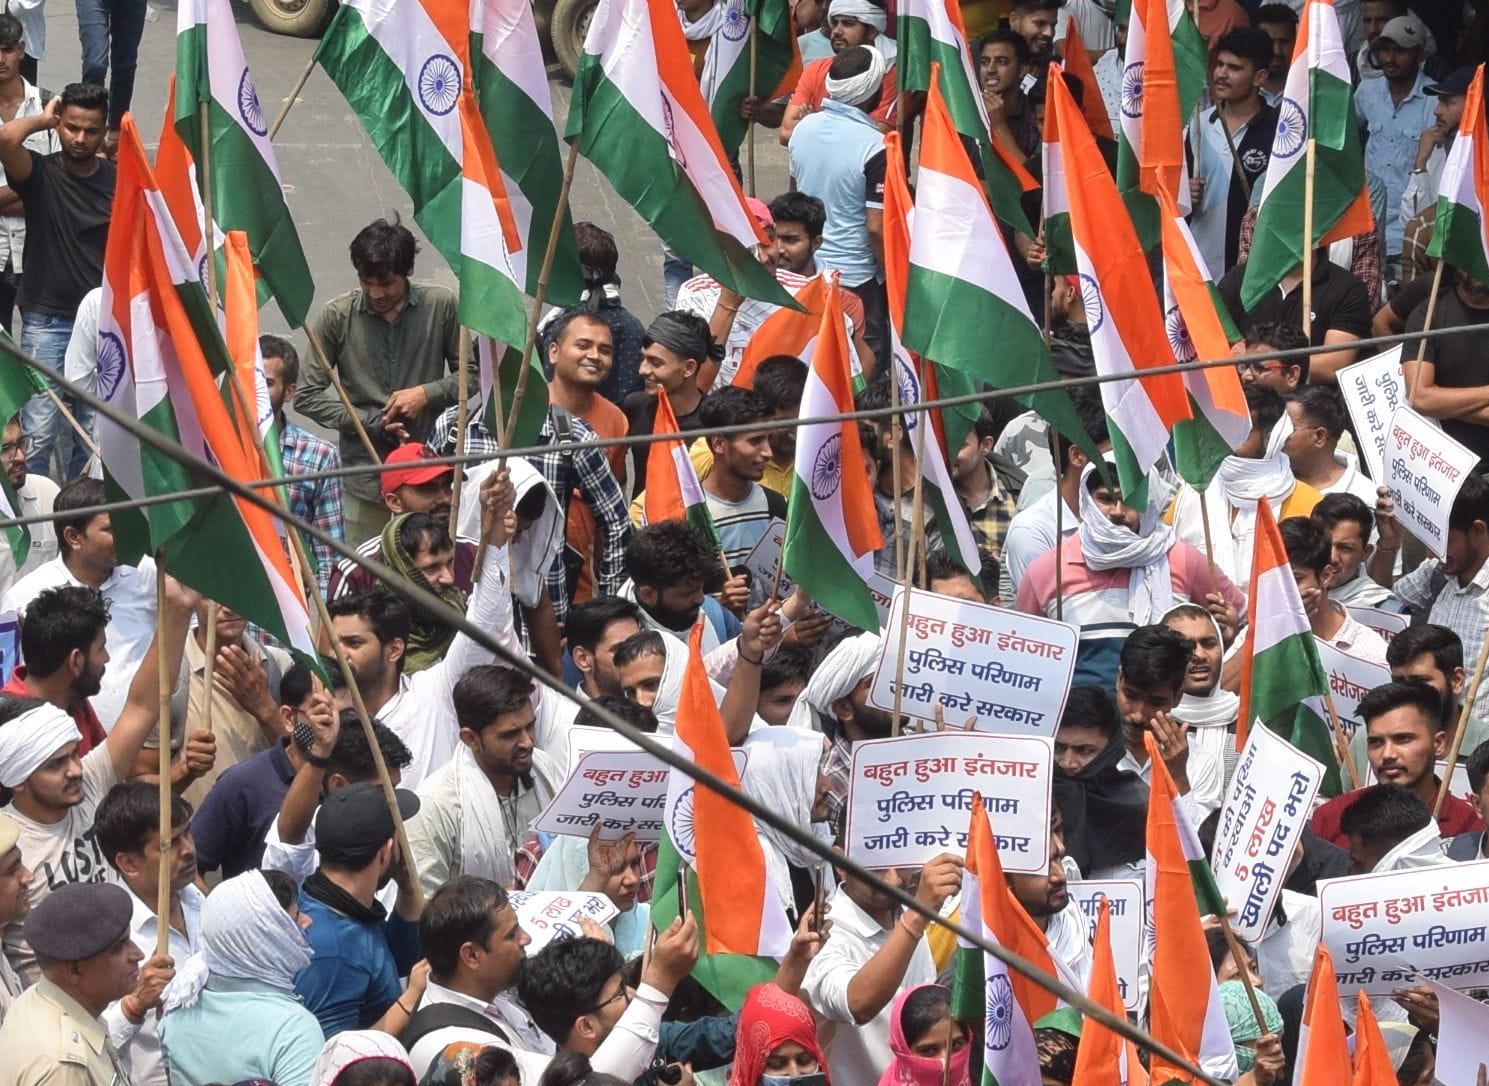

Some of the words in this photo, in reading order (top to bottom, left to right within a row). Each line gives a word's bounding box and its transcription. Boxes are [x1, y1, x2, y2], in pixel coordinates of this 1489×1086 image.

[1392, 424, 1412, 450] बहुत
[1410, 438, 1430, 461] हुआ
[1428, 451, 1461, 483] इंतजार
[1391, 458, 1414, 483] पुलिस
[1413, 476, 1442, 508] परिणाम
[1416, 511, 1442, 541] सरकार
[951, 623, 992, 648] हुआ
[997, 630, 1066, 661] इंतजार
[907, 648, 966, 675] पुलिस
[971, 661, 1042, 692] परिणाम
[938, 692, 972, 712] करे
[976, 700, 1045, 727] सरकार
[582, 768, 627, 787] बहुत
[629, 769, 669, 788] हुआ
[863, 761, 909, 787] बहुत
[914, 757, 957, 782] हुआ
[963, 752, 1039, 779] इंतजार
[578, 791, 636, 809] पुलिस
[877, 790, 935, 822] पुलिस
[556, 812, 600, 827] जारी
[602, 817, 637, 832] करे
[863, 826, 909, 850] जारी
[915, 825, 952, 847] करे
[1234, 862, 1249, 882] 5
[1244, 796, 1277, 857] लाख
[1238, 861, 1275, 929] खाली
[1265, 819, 1291, 857] पद
[1284, 770, 1310, 817] भरो
[1332, 901, 1379, 929] बहुत
[1384, 895, 1426, 925] हुआ
[1345, 933, 1407, 964] पुलिस
[1412, 925, 1487, 950] परिणाम
